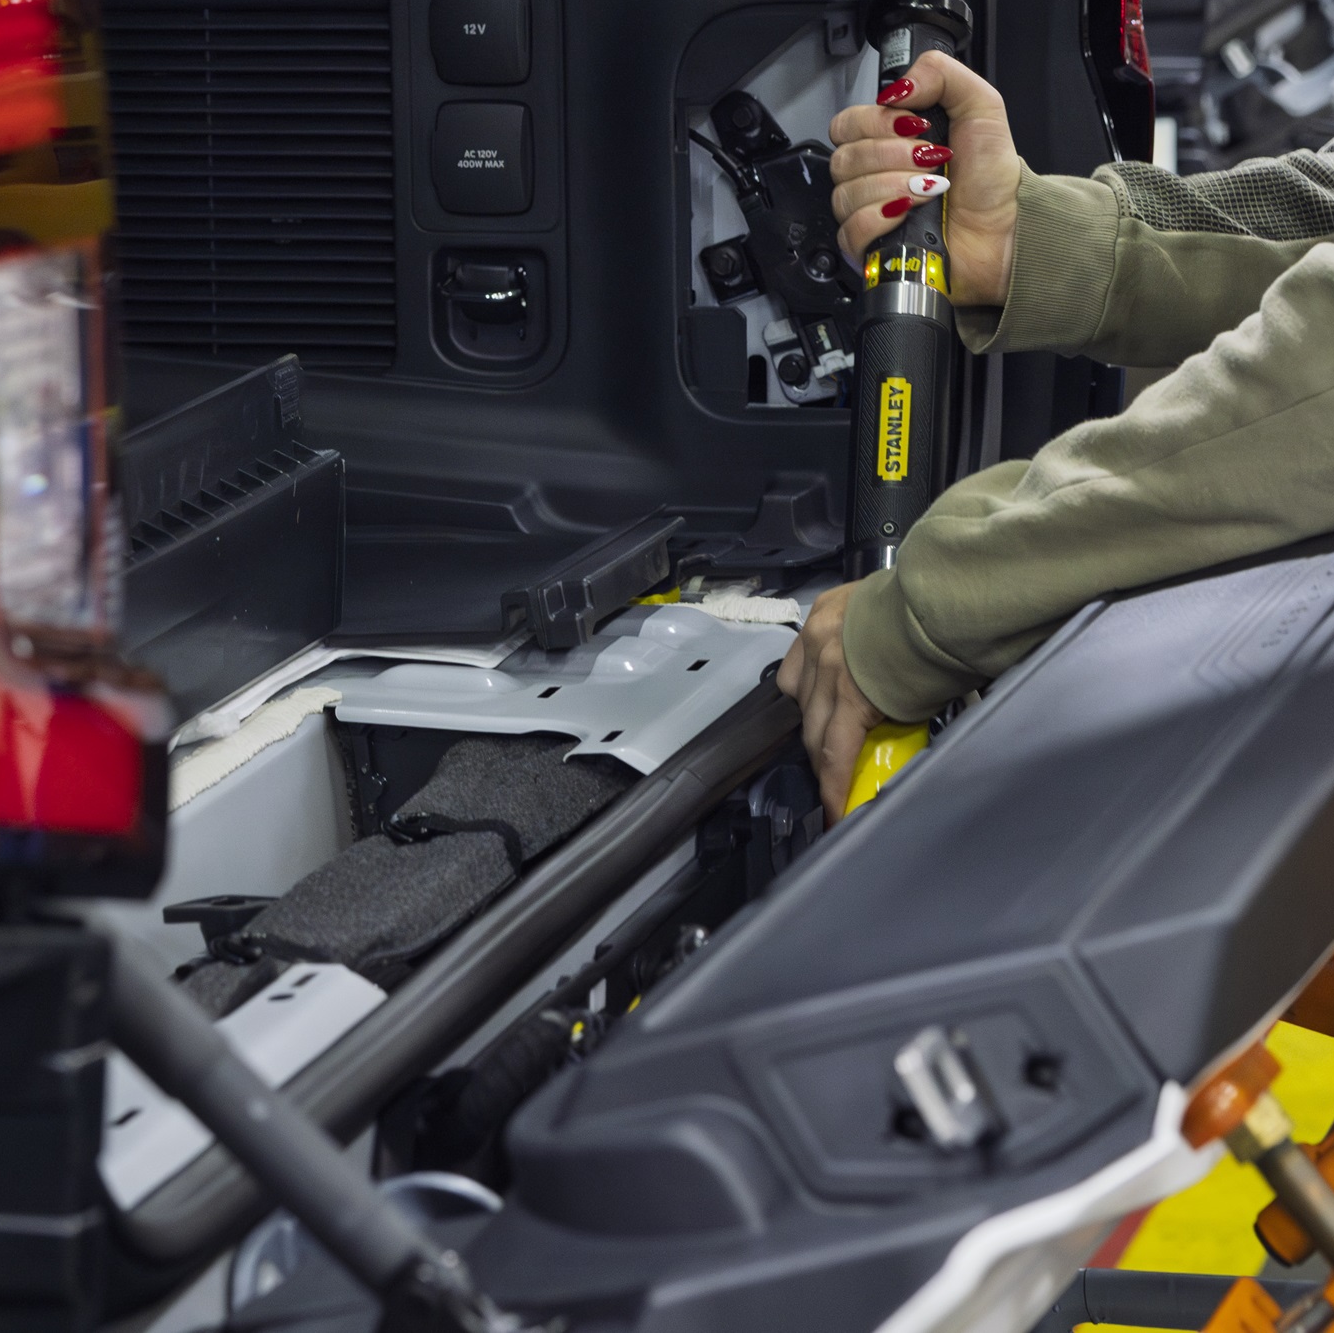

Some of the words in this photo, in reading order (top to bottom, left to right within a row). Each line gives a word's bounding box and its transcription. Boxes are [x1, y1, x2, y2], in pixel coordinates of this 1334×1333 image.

[463, 23, 487, 35] 12V
[464, 149, 476, 159] AC
[477, 149, 498, 159] 120V
[457, 160, 483, 168] 400W
[485, 160, 505, 168] MAX
[885, 385, 904, 473] STANLEY
